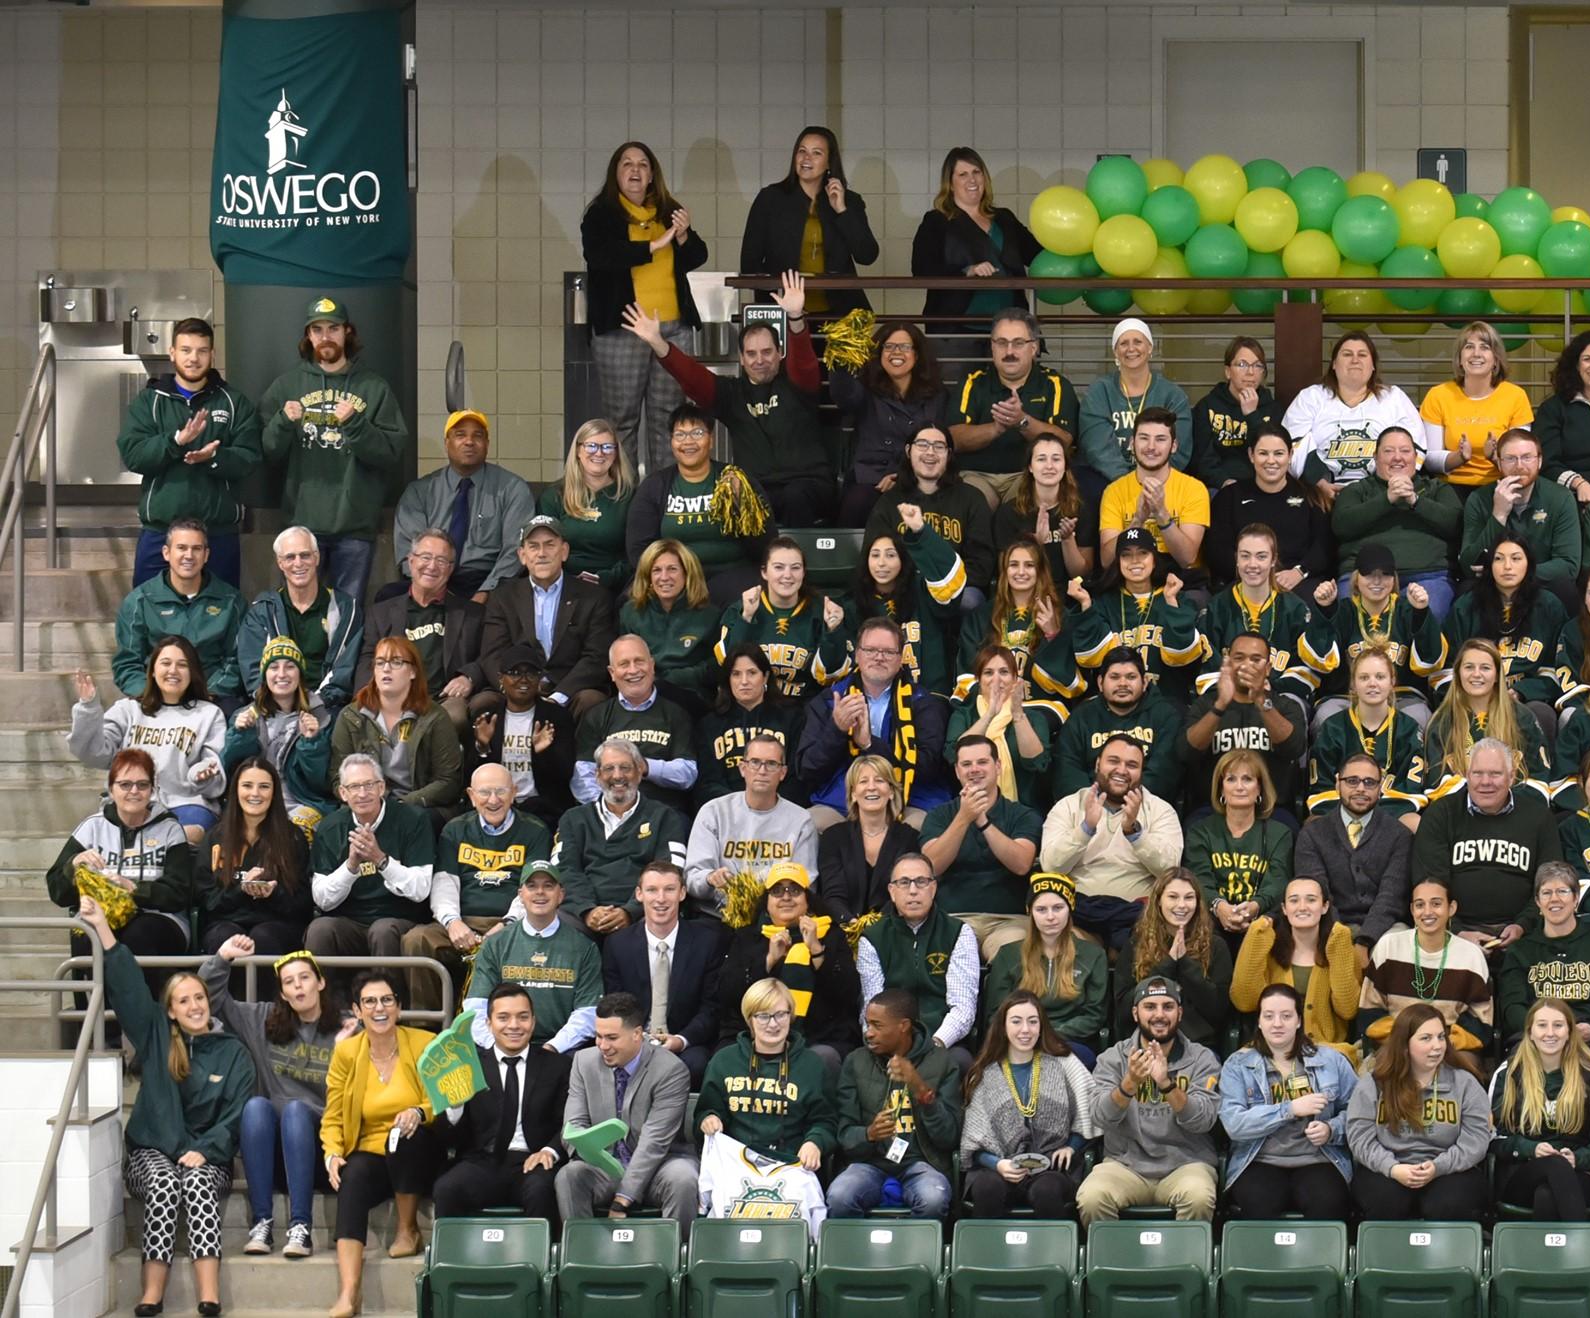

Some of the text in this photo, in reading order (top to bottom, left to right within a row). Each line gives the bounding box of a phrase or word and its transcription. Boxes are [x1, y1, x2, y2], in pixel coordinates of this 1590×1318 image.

[222, 170, 381, 216] OSWEGO
[216, 214, 380, 229] STATE UNIVERSITY OF NEW YORK
[747, 310, 783, 320] SECTION
[666, 494, 714, 513] OSWE
[1556, 665, 1583, 693] 2
[642, 729, 671, 746] STATE
[1407, 755, 1424, 783] 2
[98, 846, 167, 868] AKERS
[723, 840, 791, 860] OSWEGO
[1452, 838, 1531, 872] OSWEGO
[487, 1230, 500, 1241] 20
[617, 1231, 630, 1242] 19
[1279, 1233, 1292, 1244] 14
[1414, 1234, 1427, 1245] 13
[1549, 1235, 1562, 1246] 12
